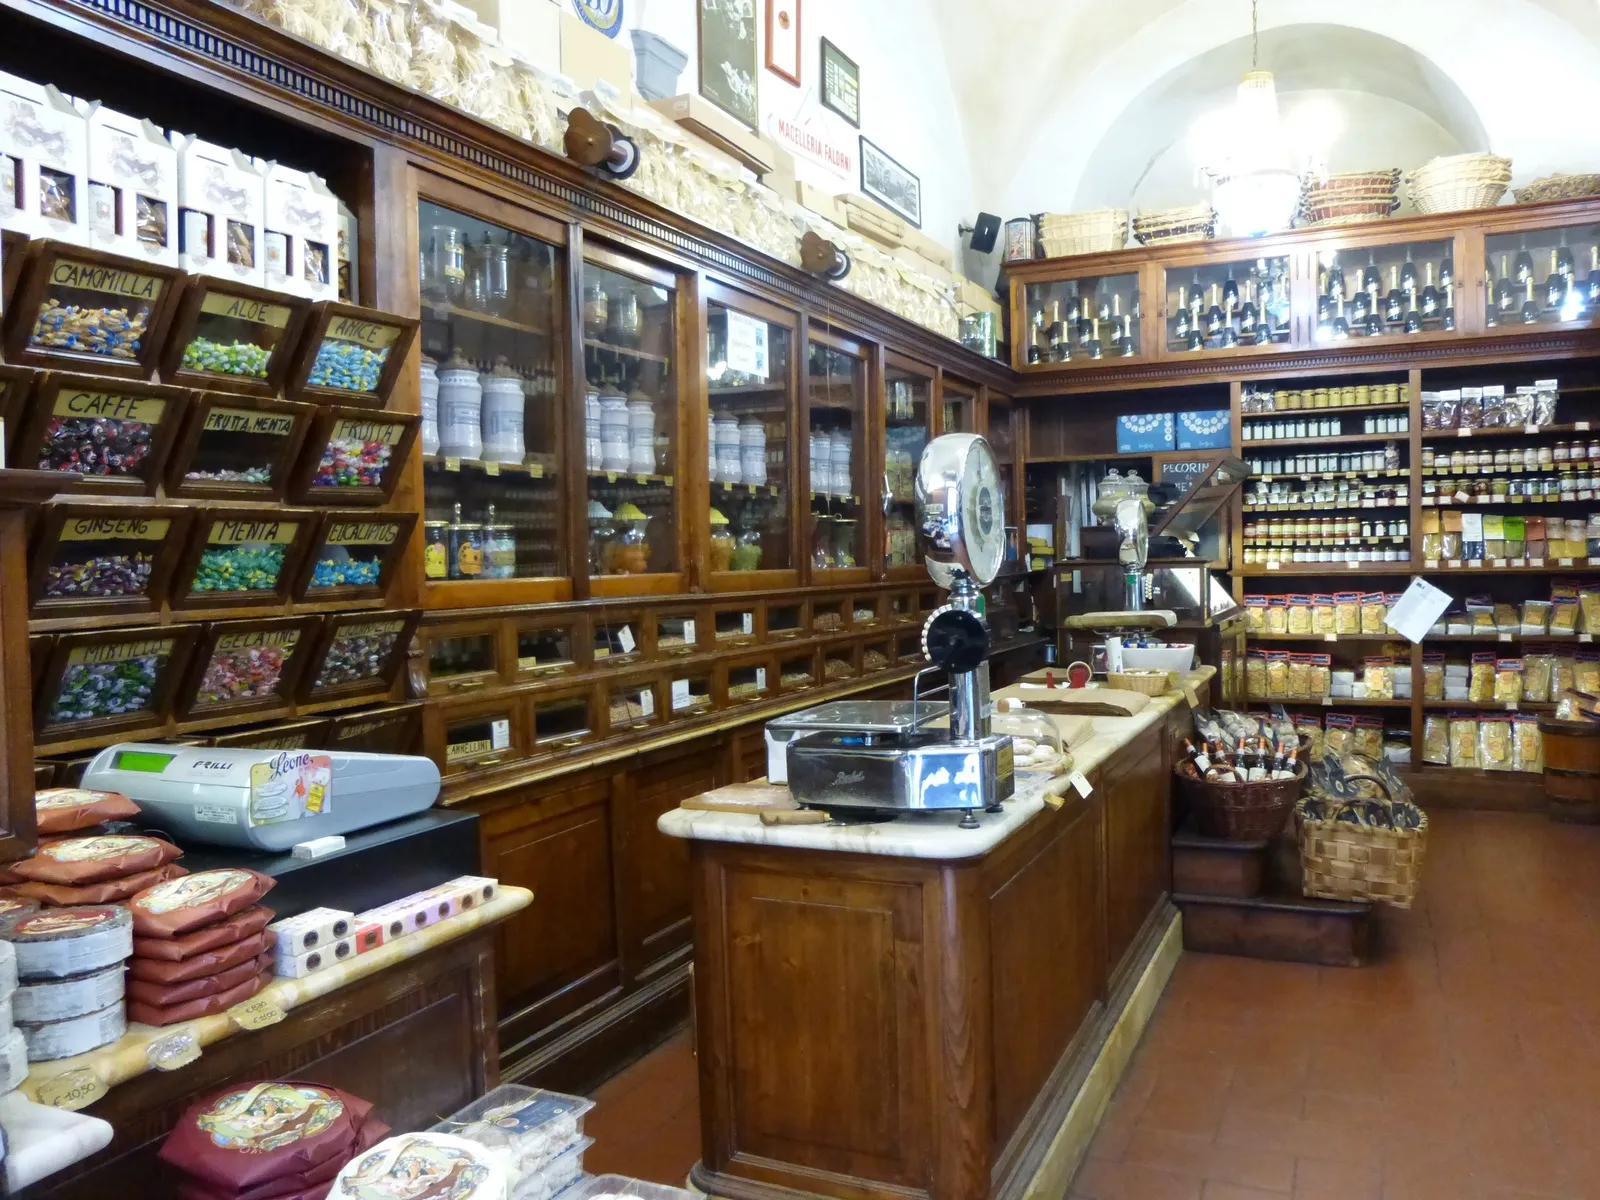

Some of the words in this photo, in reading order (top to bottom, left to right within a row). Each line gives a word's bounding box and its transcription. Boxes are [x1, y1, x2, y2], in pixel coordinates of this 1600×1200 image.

[778, 118, 823, 158] MACELLERIA
[53, 263, 155, 298] CAMOMILLA
[226, 300, 267, 323] ALOE
[253, 417, 293, 432] MENTA
[338, 420, 394, 443] FRUTTA
[1162, 462, 1210, 473] PECORIN
[74, 518, 149, 536] GINSENG
[217, 520, 280, 541] MENTA
[219, 630, 298, 649] GELATINE
[269, 751, 310, 781] Leone
